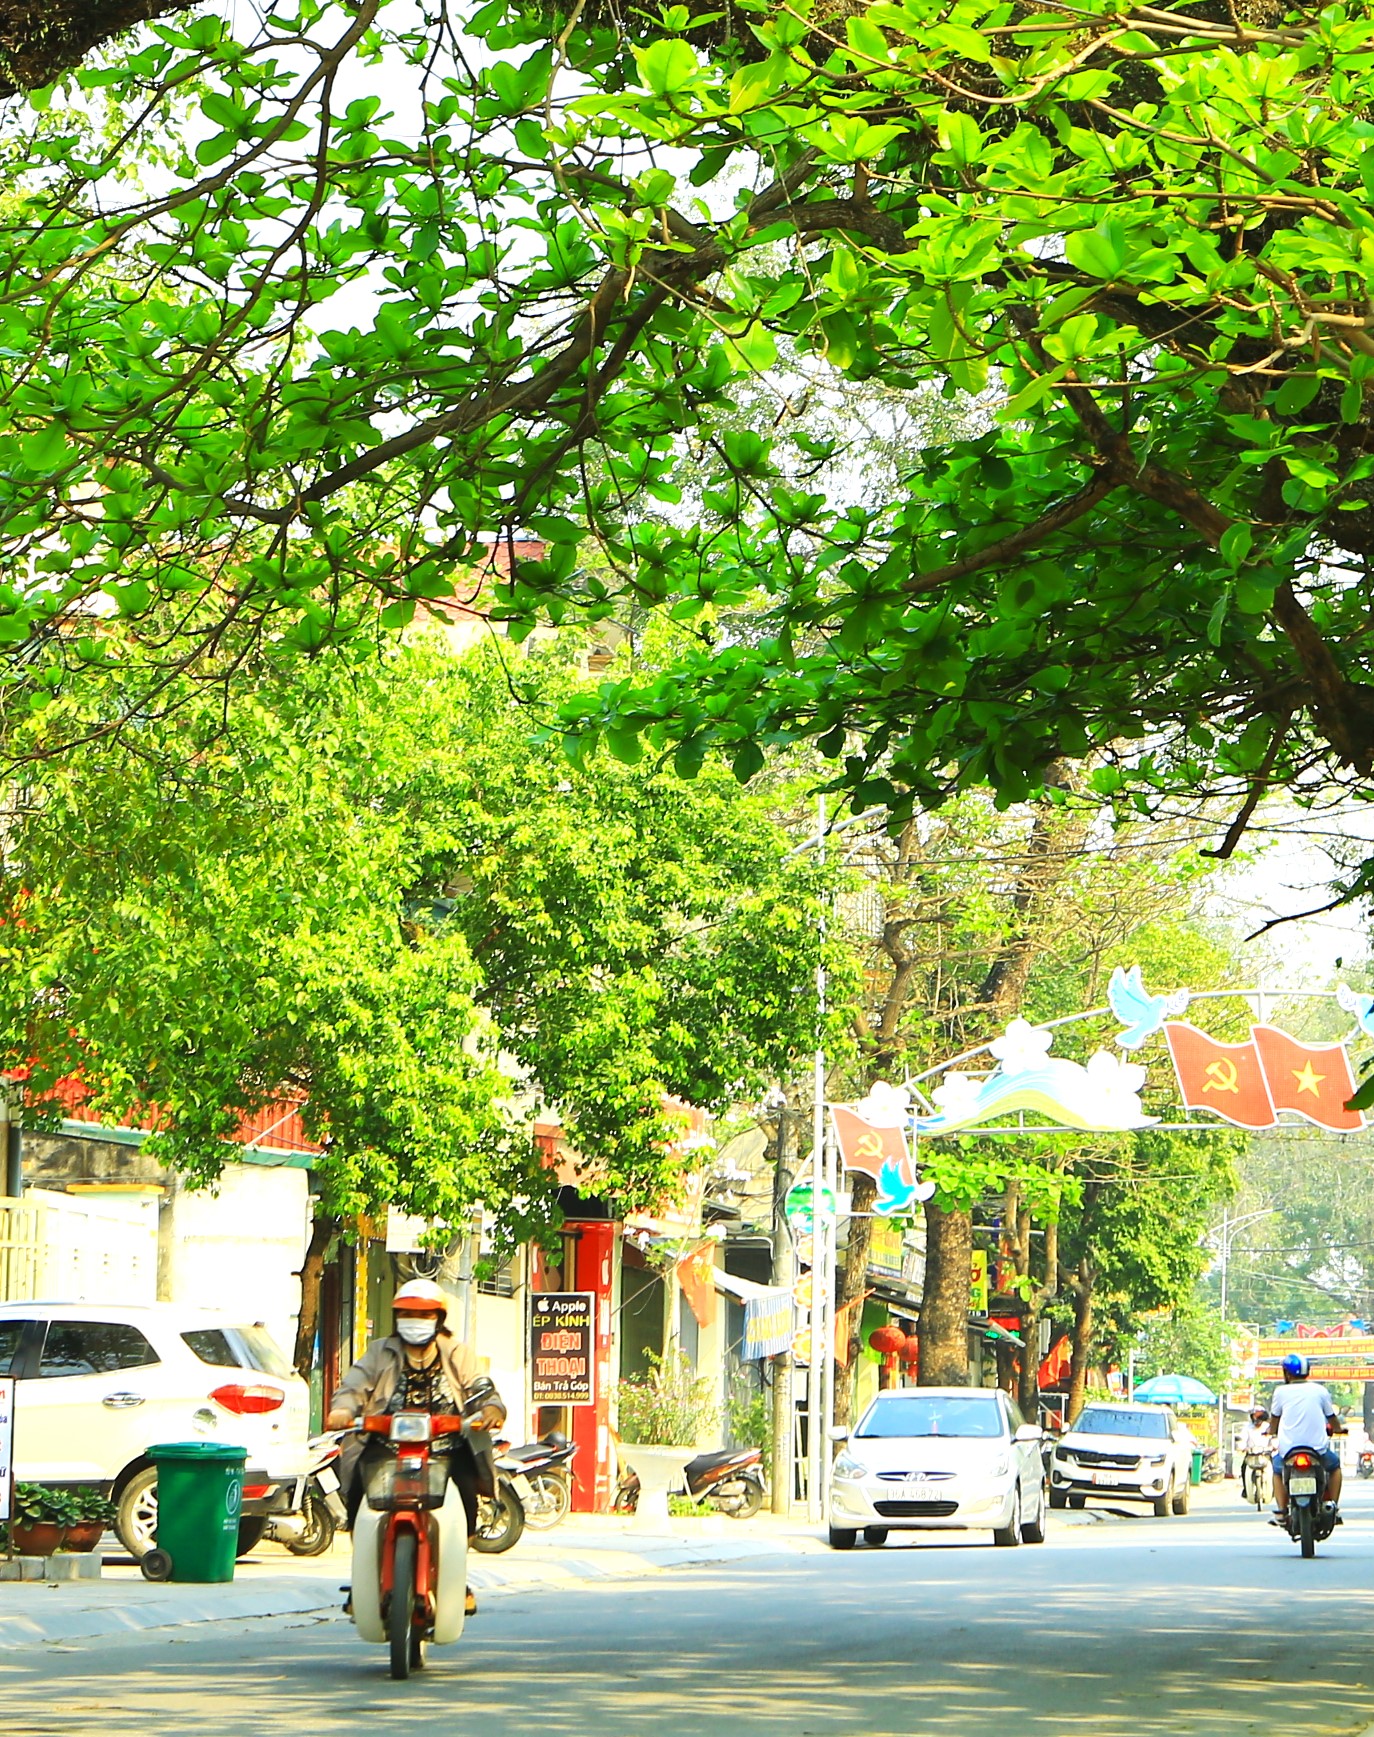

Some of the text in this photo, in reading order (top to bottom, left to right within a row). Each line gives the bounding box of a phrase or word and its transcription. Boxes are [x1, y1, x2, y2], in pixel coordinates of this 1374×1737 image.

[552, 1301, 587, 1315] Apple
[533, 1313, 590, 1327] ÉP KÍNH
[541, 1329, 582, 1354] ĐIỆN
[536, 1357, 586, 1379] THOẠI
[534, 1380, 589, 1393] Bán Trả Góp
